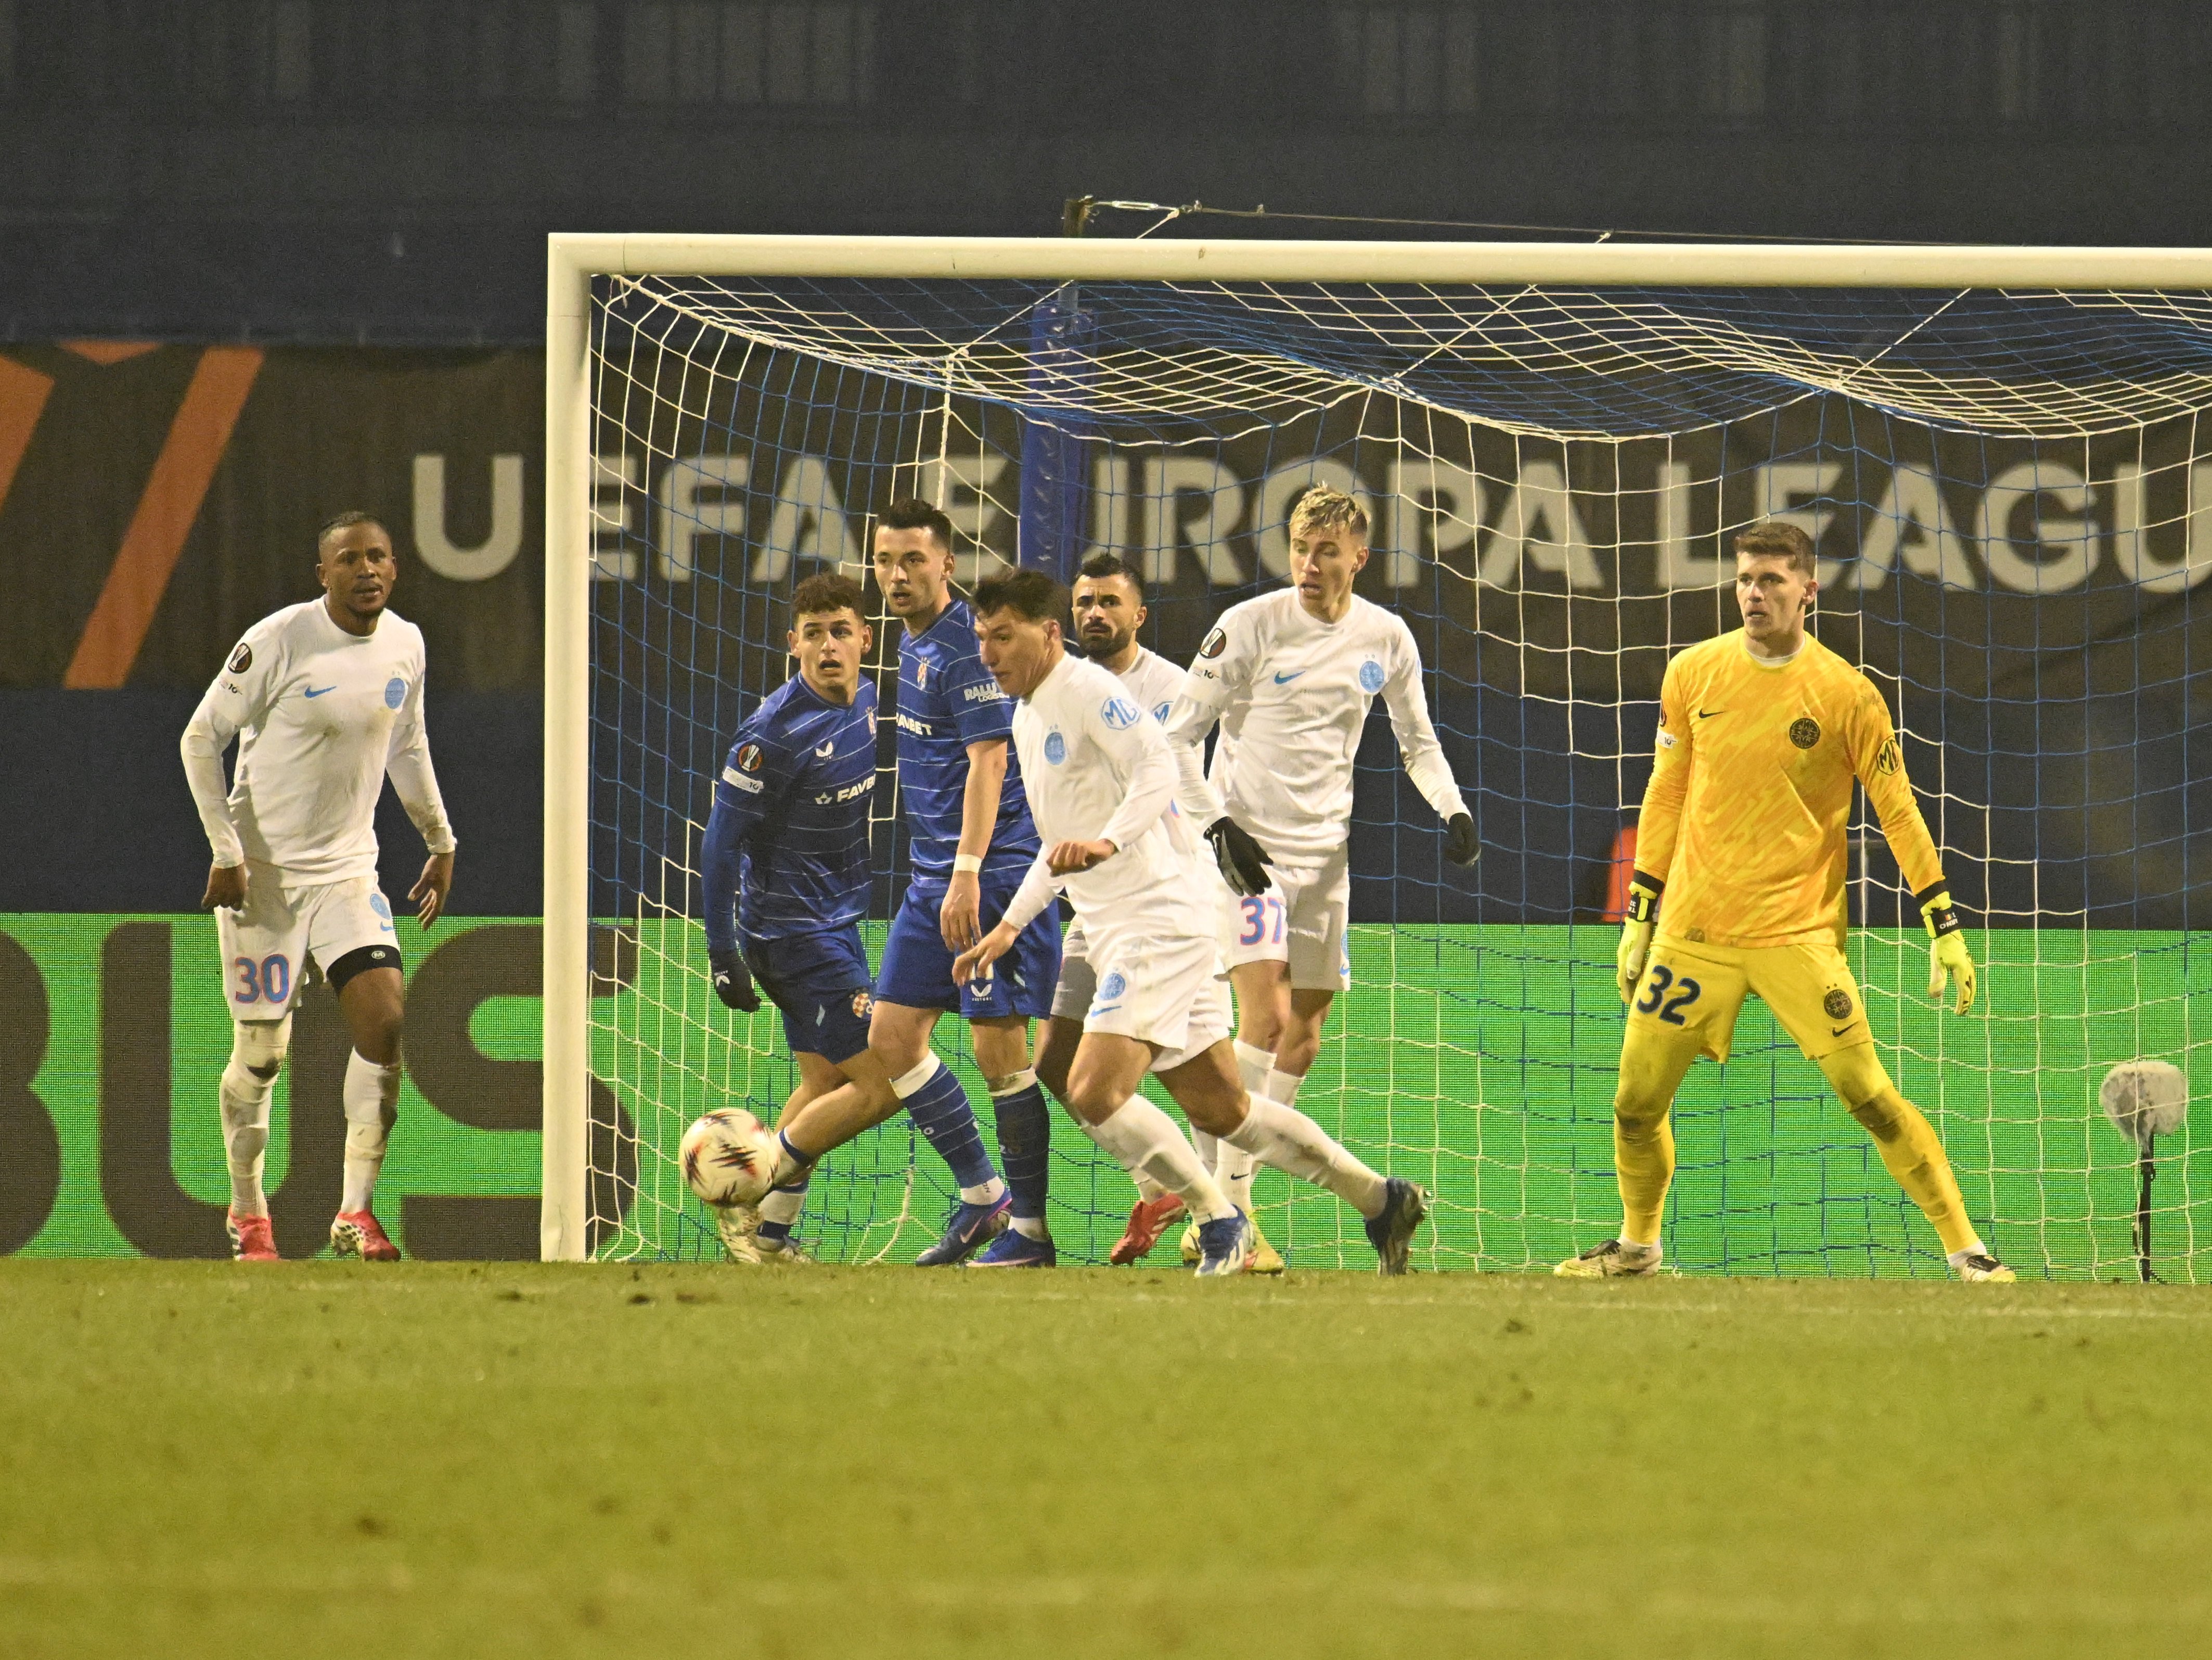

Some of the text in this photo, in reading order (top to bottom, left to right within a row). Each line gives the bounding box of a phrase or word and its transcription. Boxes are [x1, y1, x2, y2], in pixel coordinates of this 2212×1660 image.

[896, 712, 932, 735] AVBET
[837, 773, 876, 802] FAVB
[1240, 896, 1282, 946] 37
[235, 953, 289, 1004] 30
[1636, 964, 1701, 1026] 32
